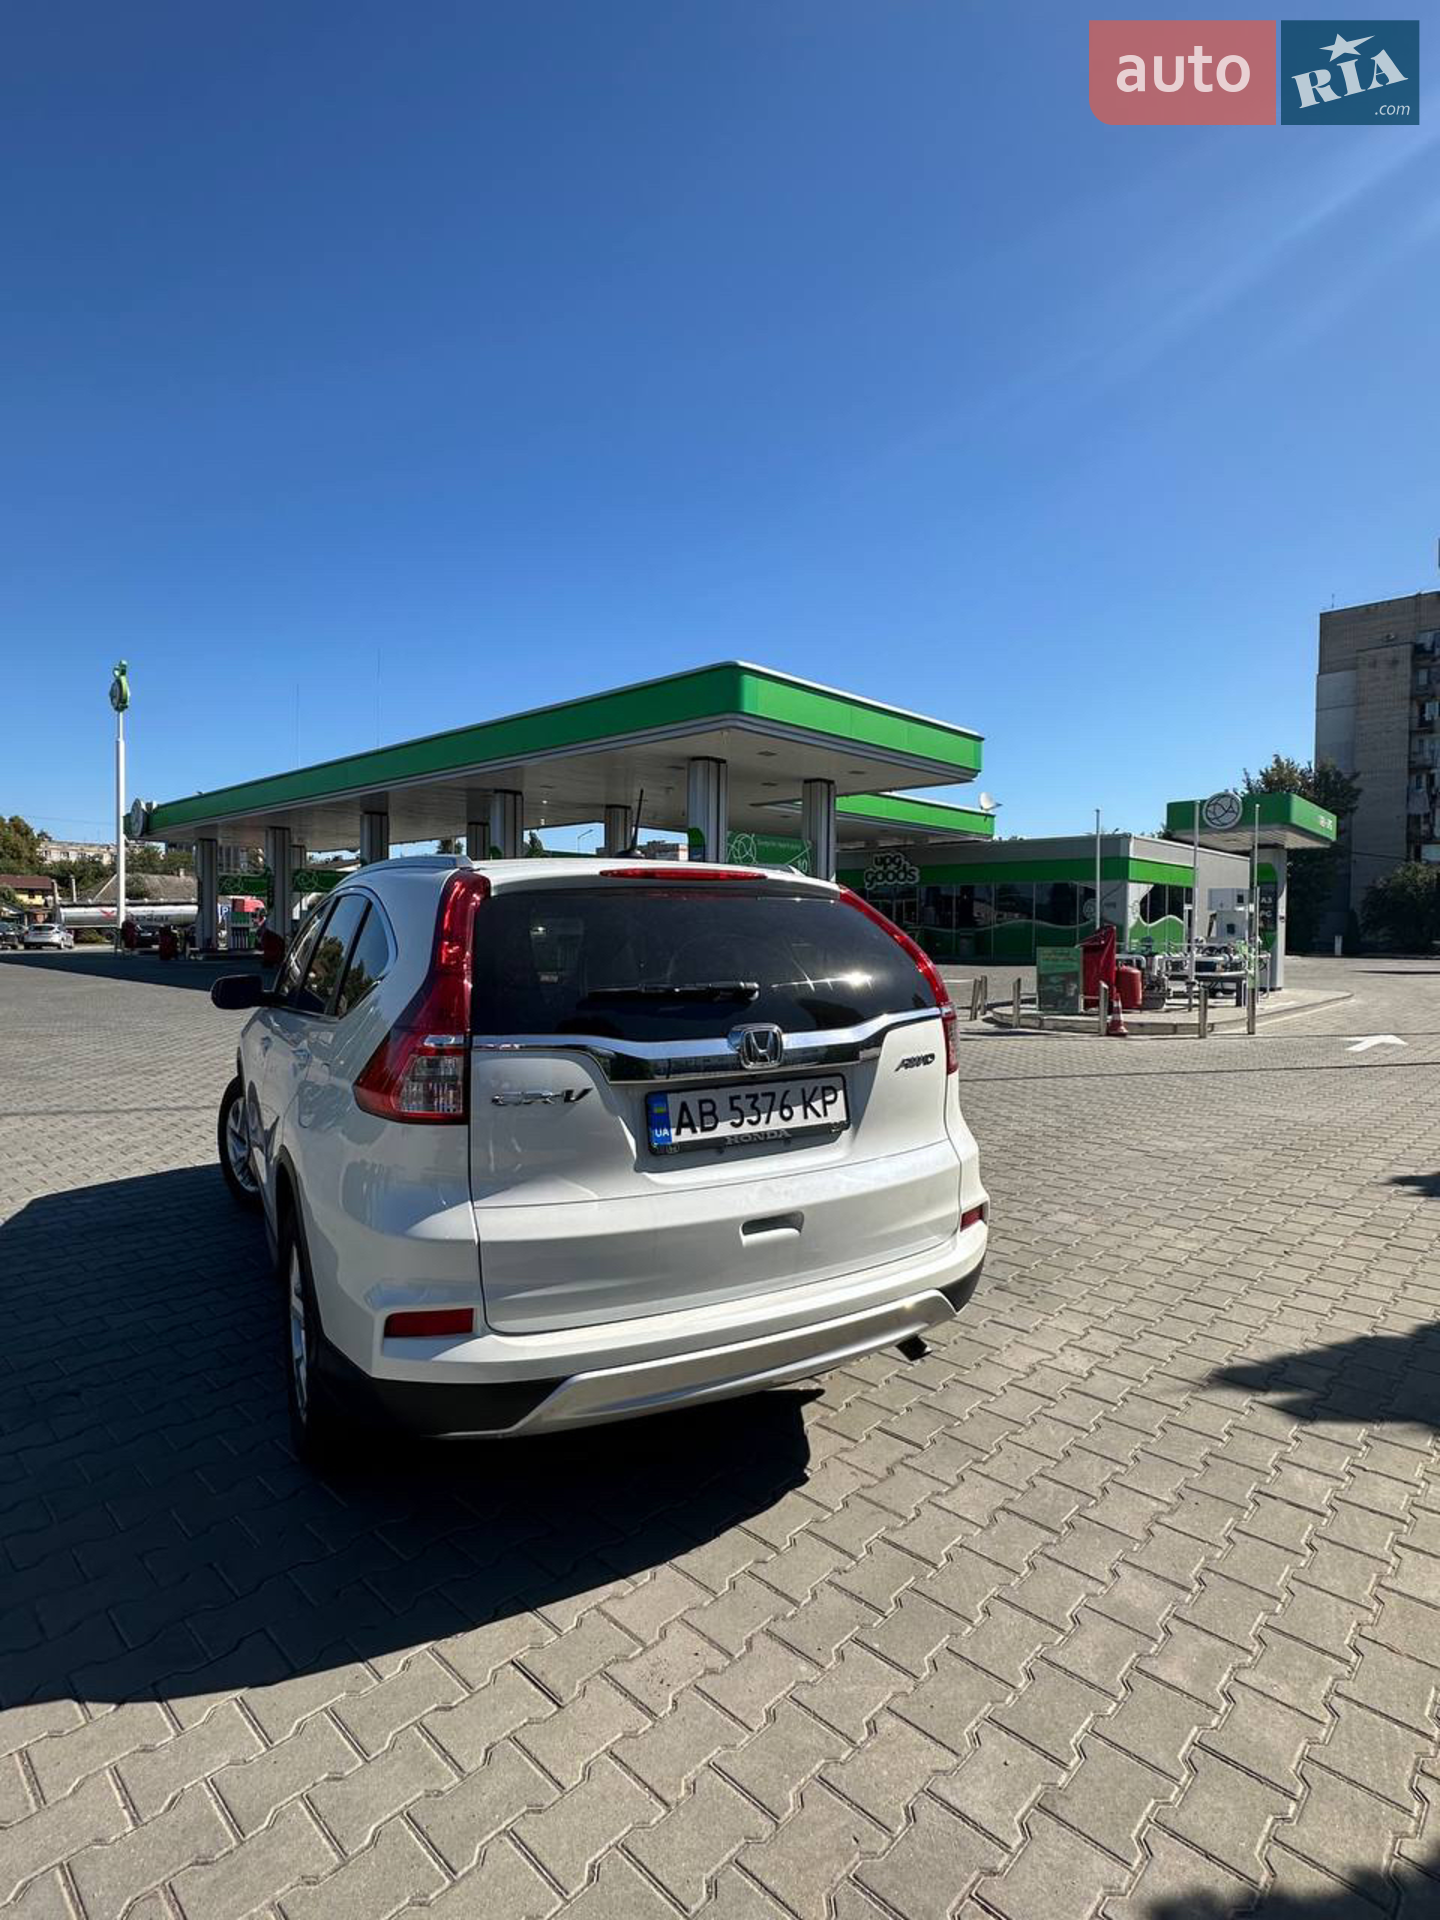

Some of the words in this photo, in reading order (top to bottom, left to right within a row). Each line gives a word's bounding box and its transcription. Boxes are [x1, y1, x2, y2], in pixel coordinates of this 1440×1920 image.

[874, 853, 903, 870] upg
[864, 862, 917, 888] goods
[675, 1098, 719, 1136] AB
[729, 1090, 794, 1128] 5376
[801, 1085, 838, 1120] KP
[654, 1128, 670, 1138] UA
[725, 1128, 792, 1146] HONDA
